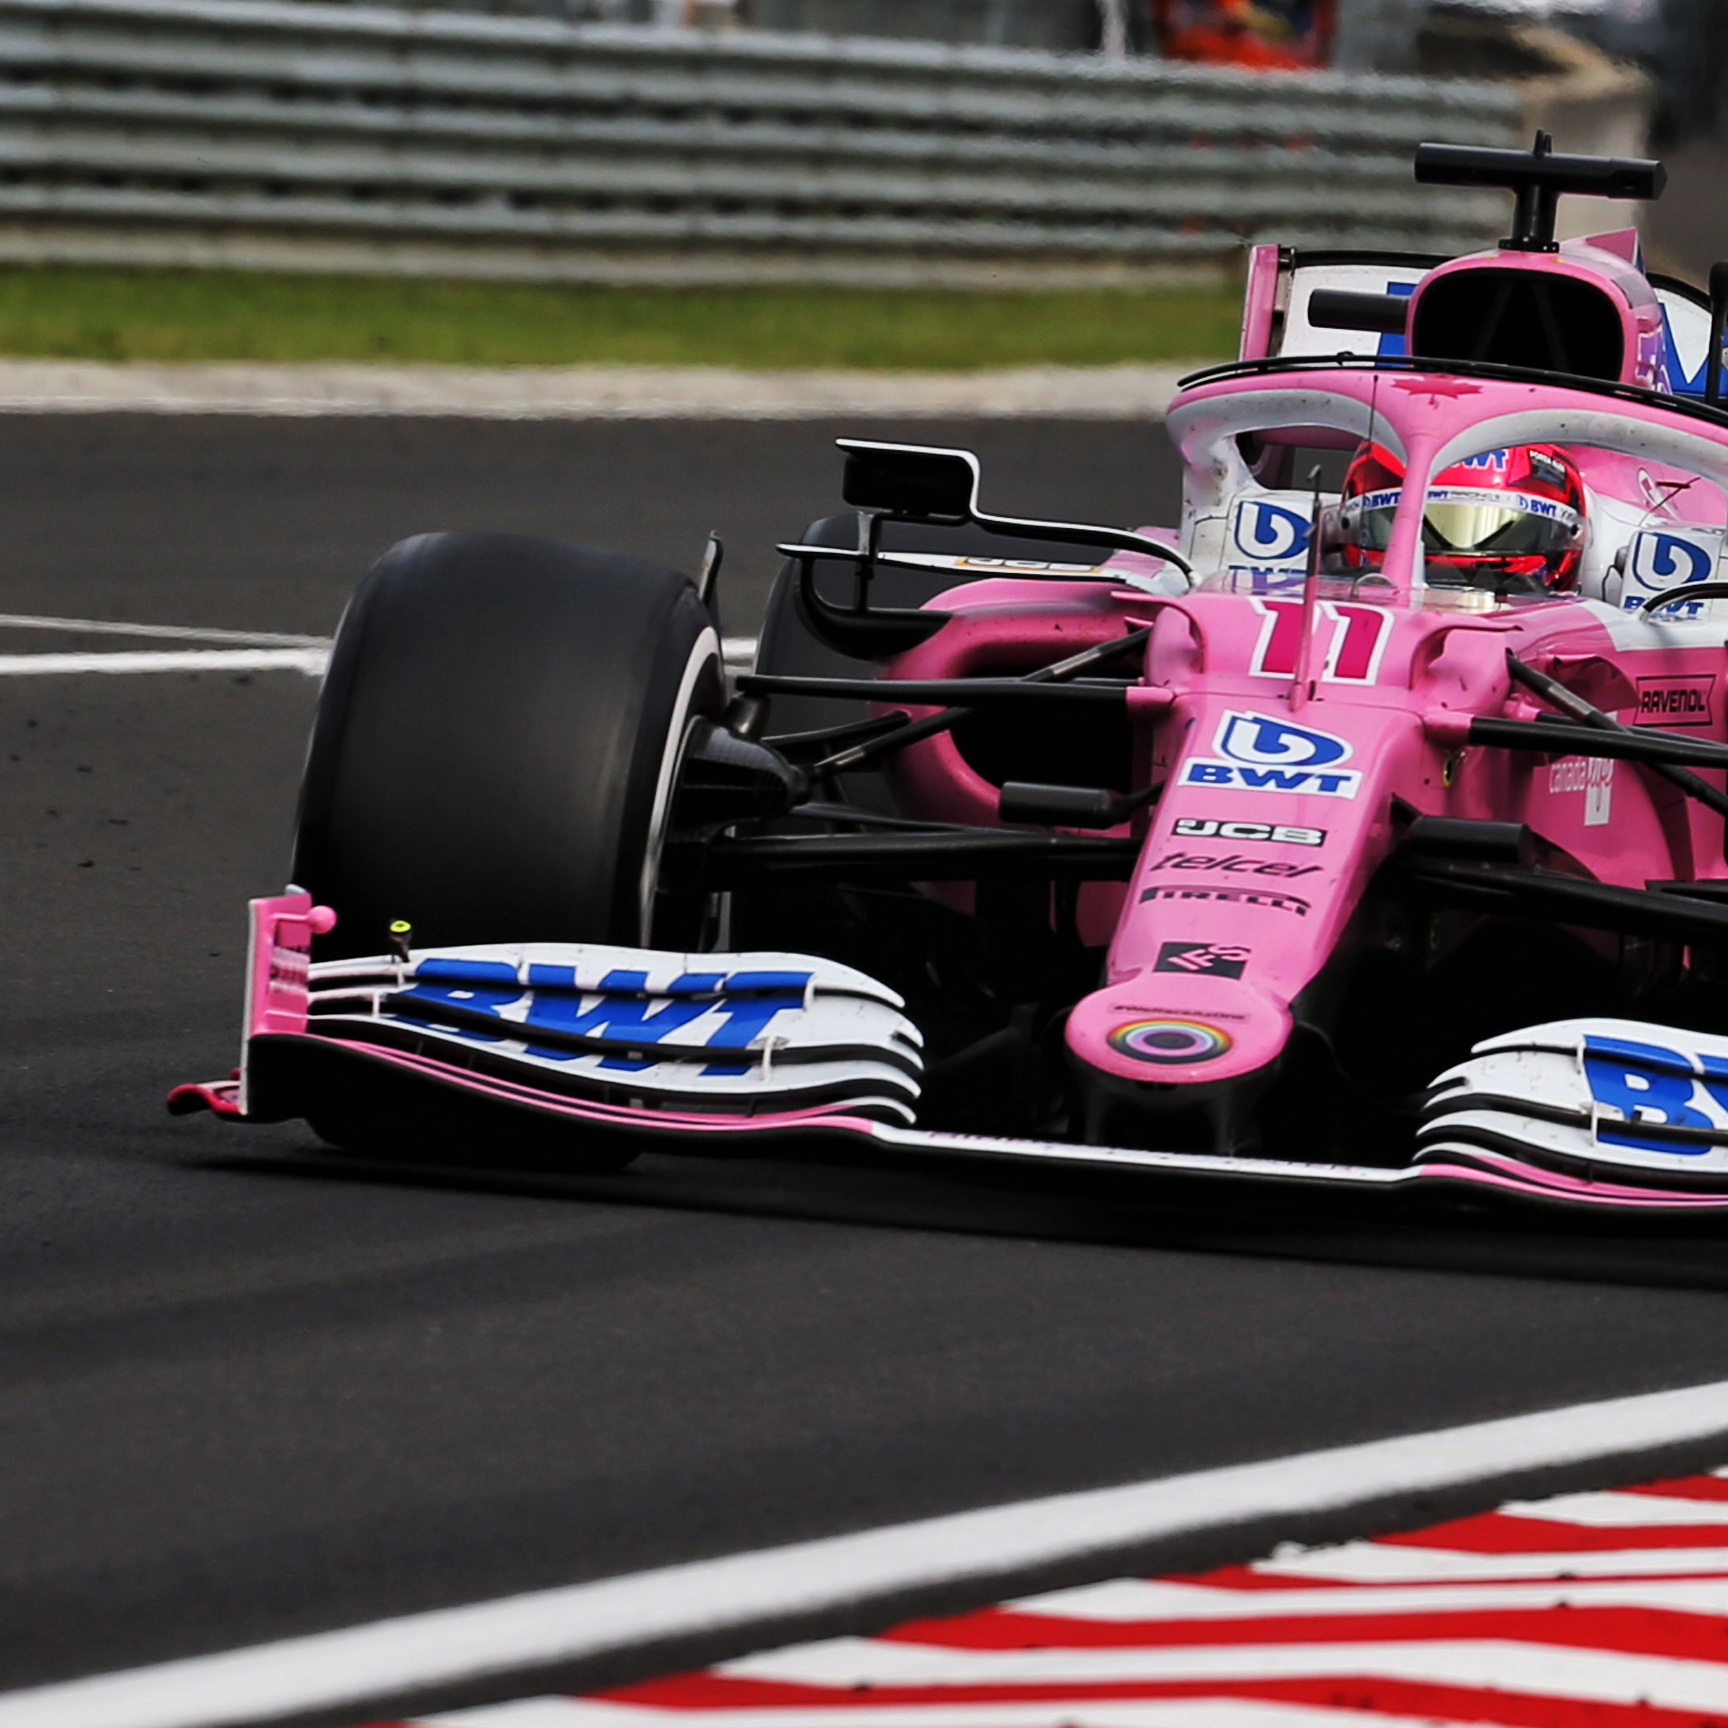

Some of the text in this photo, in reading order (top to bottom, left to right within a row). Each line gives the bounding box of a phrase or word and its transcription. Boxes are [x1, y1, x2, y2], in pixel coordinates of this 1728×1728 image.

[1456, 449, 1508, 470] WT
[1530, 499, 1557, 516] BWT
[1249, 596, 1395, 685] 11
[1640, 689, 1706, 714] RAVENOL
[1187, 763, 1353, 793] BWT
[1175, 819, 1323, 846] JCB
[1150, 851, 1325, 878] telcel
[1139, 884, 1312, 917] PIRELLI
[388, 957, 814, 1077] BWT
